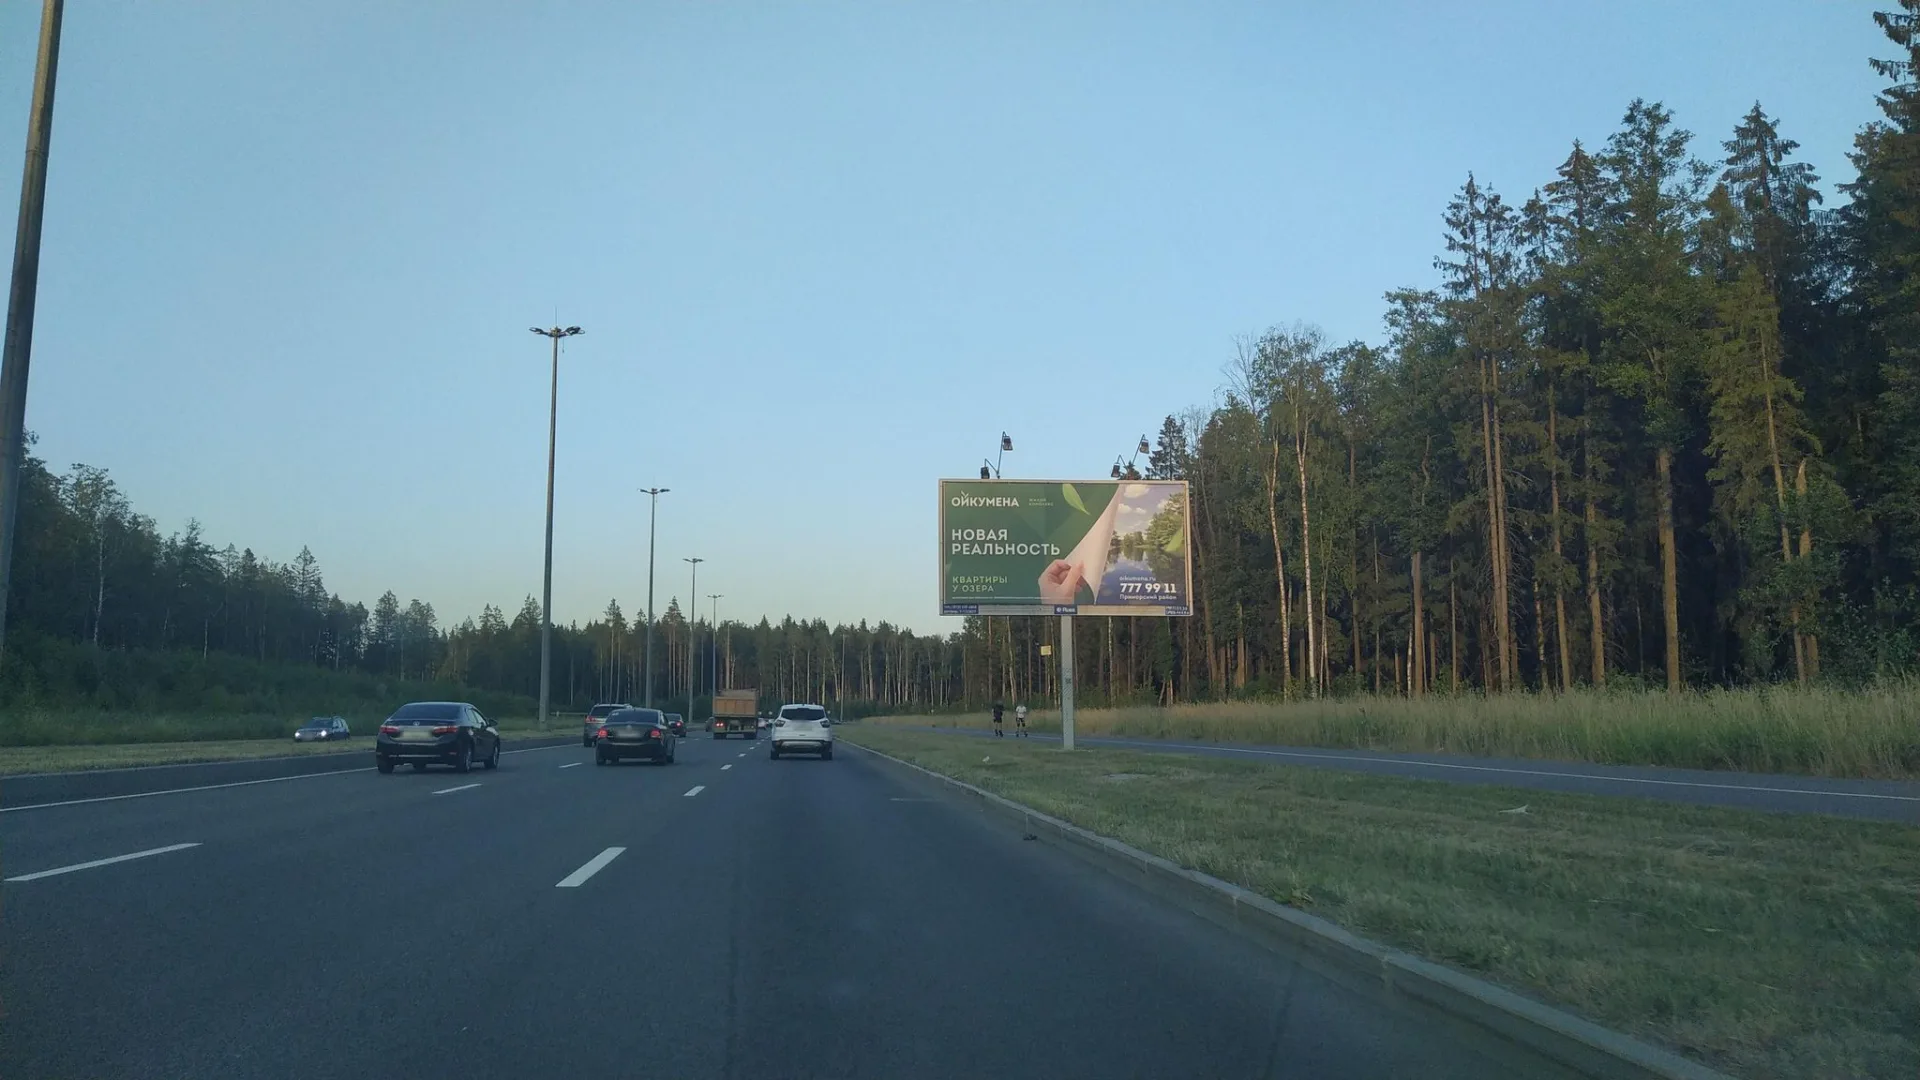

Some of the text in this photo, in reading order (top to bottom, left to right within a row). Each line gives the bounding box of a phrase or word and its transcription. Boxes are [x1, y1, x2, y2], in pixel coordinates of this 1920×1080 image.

[951, 490, 1020, 507] ОЙКУМЕНА
[951, 528, 1008, 541] НОВАЯ
[951, 543, 1061, 556] РЕАЛЬНОСТЬ
[952, 576, 1008, 584] КВАРТИРЫ
[952, 585, 995, 593] У ОЗЕРА
[1119, 583, 1177, 593] 777 99 11
